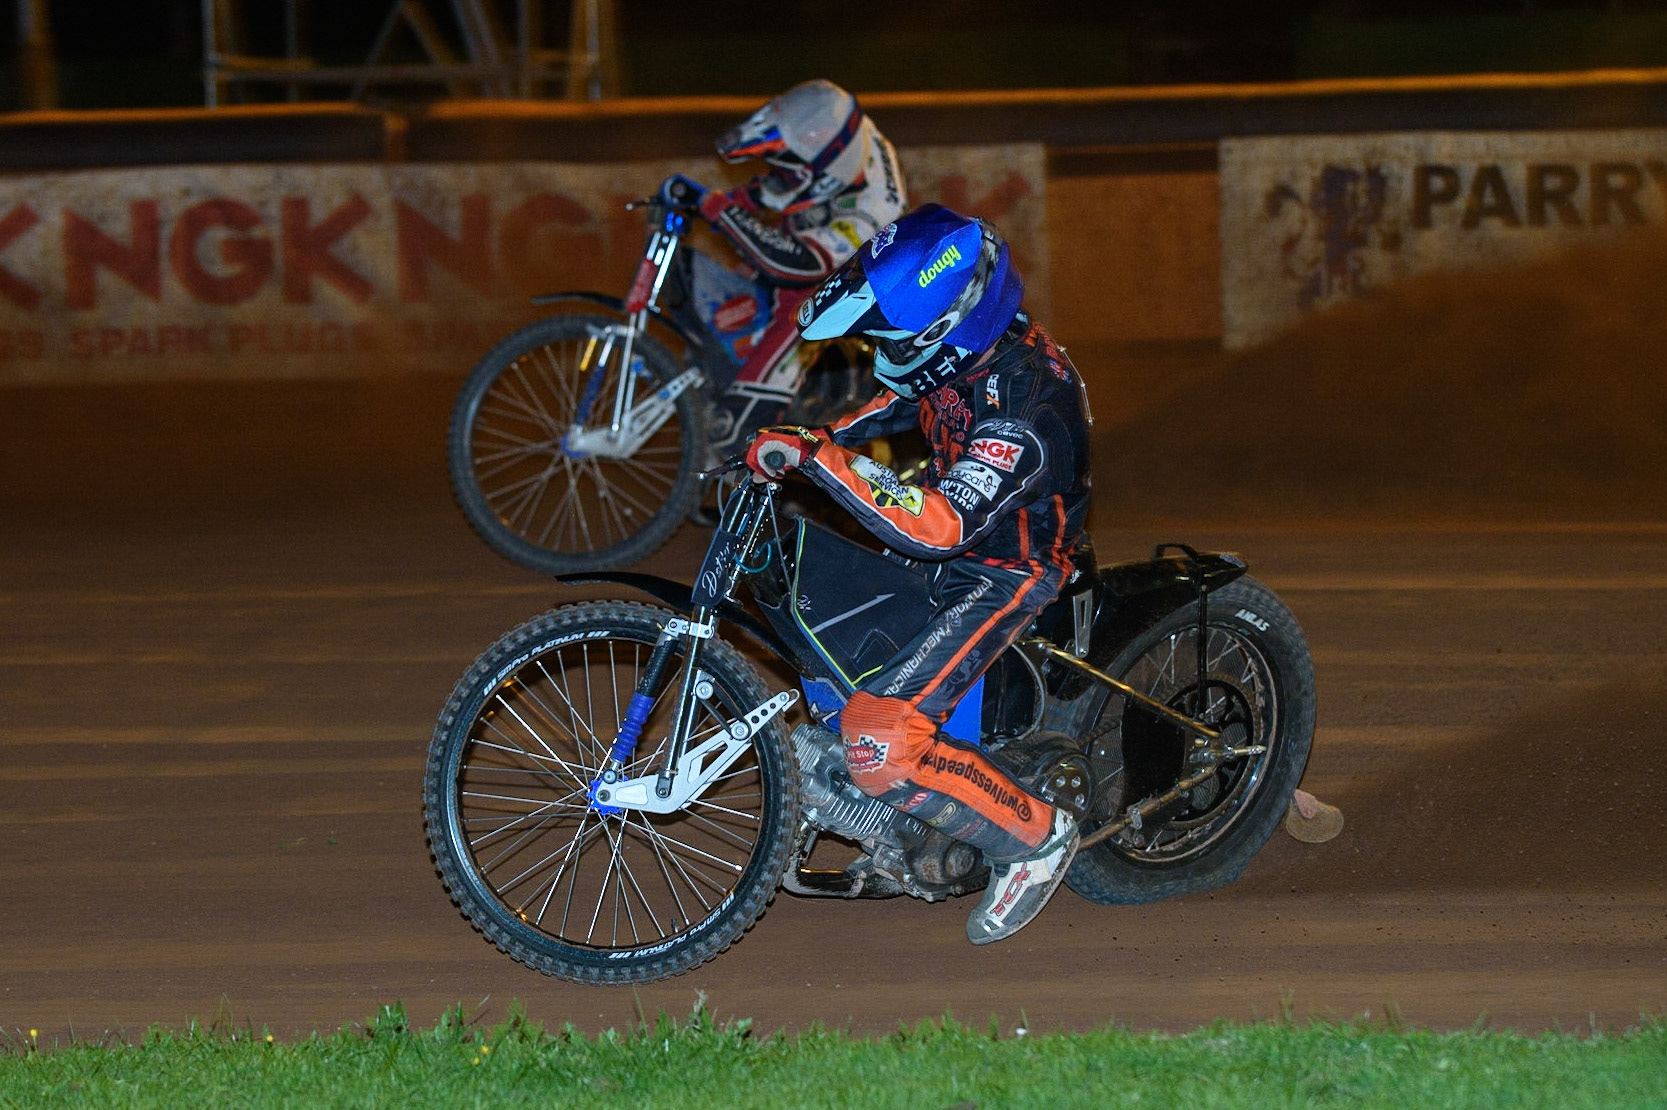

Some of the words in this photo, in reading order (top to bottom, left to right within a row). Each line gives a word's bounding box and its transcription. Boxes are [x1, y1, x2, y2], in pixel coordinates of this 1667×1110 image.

[63, 198, 374, 309] NGK
[918, 244, 963, 288] dougy
[71, 325, 214, 359] SPARK
[969, 438, 1020, 465] NGK
